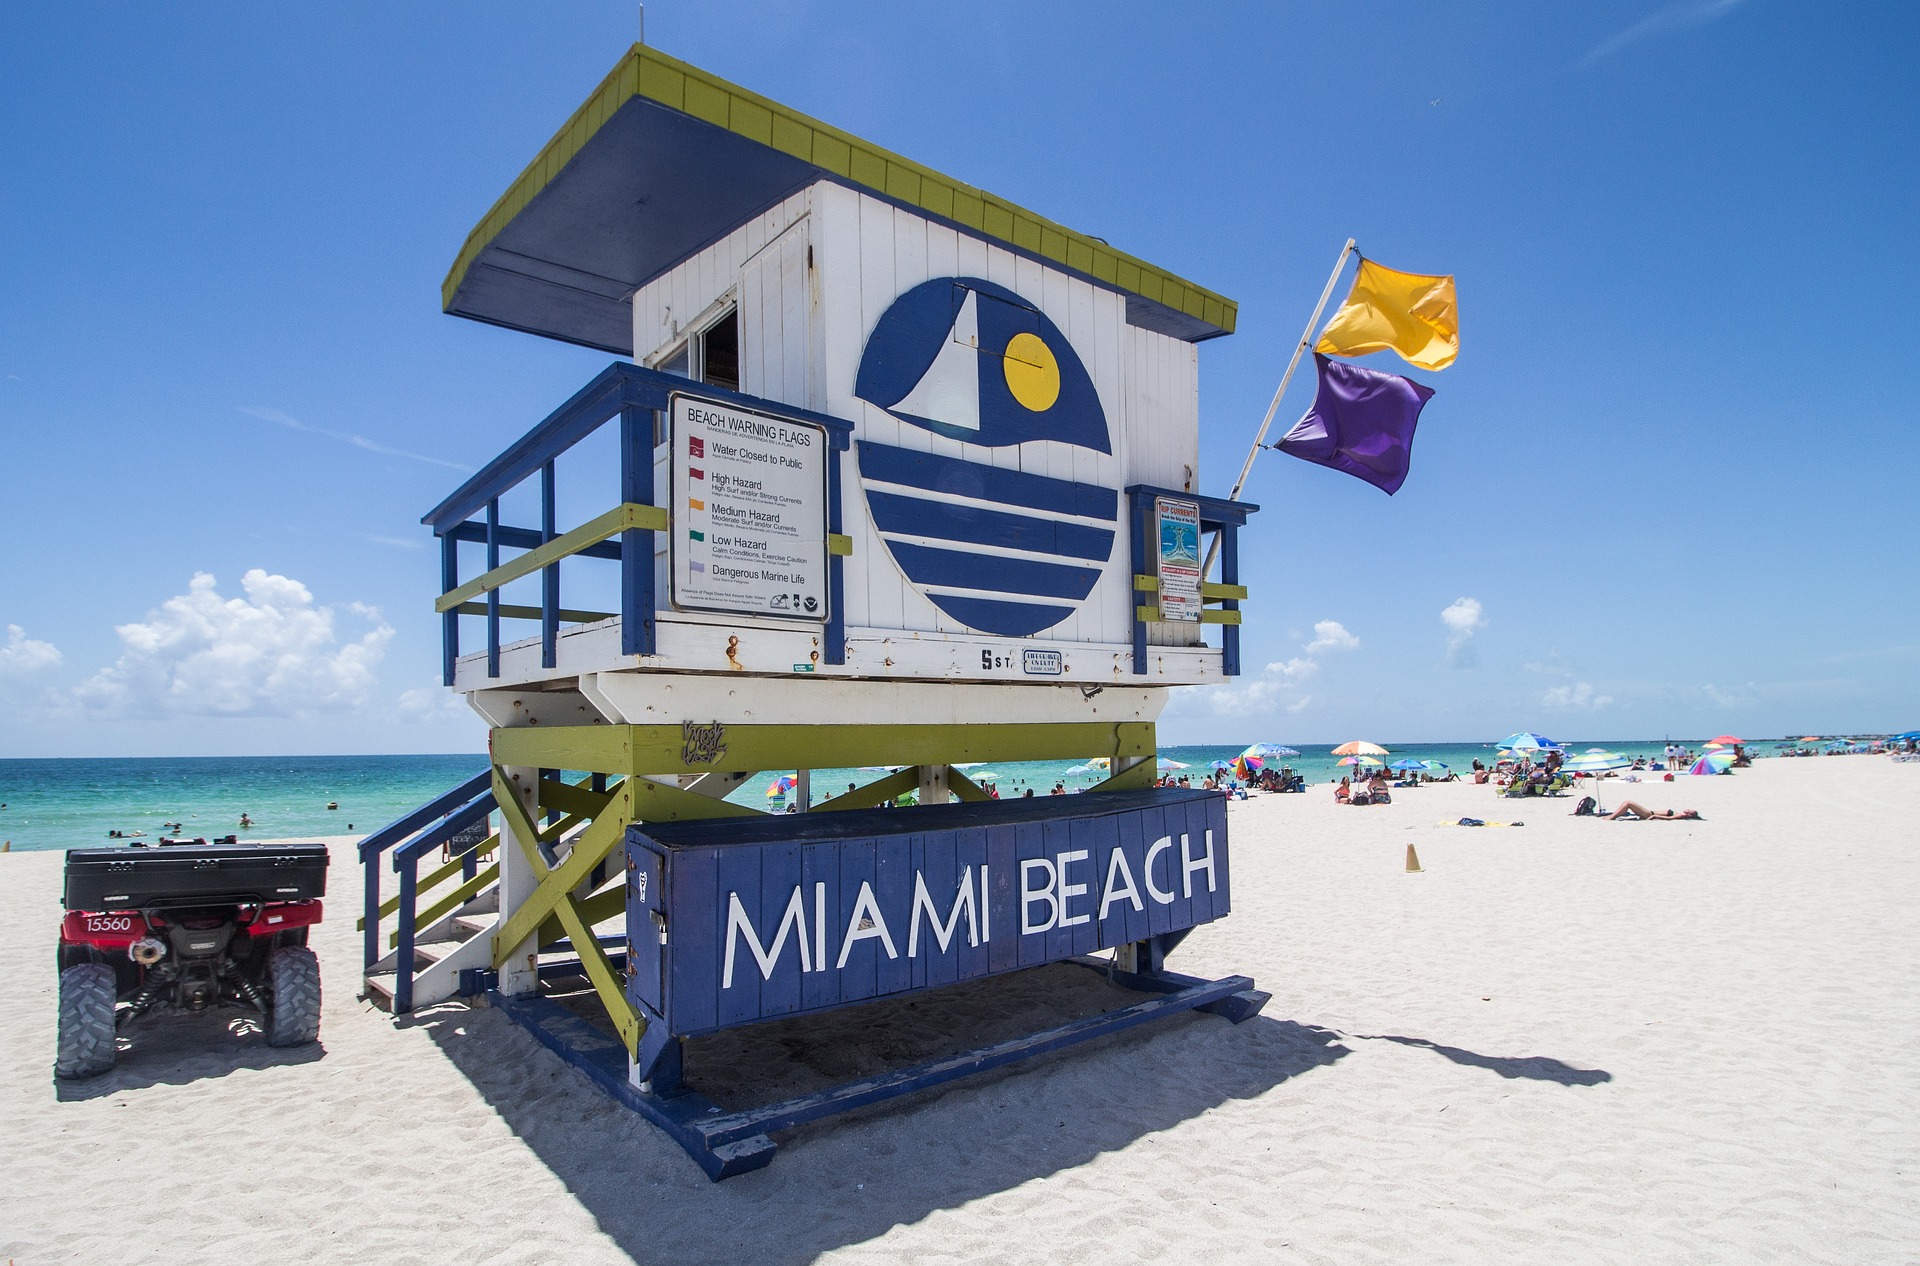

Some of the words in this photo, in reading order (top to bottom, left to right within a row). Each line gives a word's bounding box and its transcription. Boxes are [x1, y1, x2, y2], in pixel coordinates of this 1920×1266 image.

[688, 408, 725, 428] BEACH
[728, 417, 777, 439] WARNING
[779, 429, 810, 447] FLAGS
[712, 442, 737, 456] Water
[739, 448, 768, 462] Closed
[770, 454, 778, 465] to
[780, 456, 803, 470] Public
[711, 472, 730, 486] High
[732, 475, 762, 490] Hazard
[711, 484, 725, 492] High
[740, 489, 758, 497] and/or
[759, 492, 778, 501] Strong
[779, 495, 802, 505] Currents
[711, 503, 747, 518] Medium
[749, 509, 780, 523] Hazard
[1160, 505, 1169, 513] RIP
[1170, 507, 1197, 518] CURRENTS
[712, 514, 740, 524] Moderate
[741, 518, 754, 526] Surf
[754, 520, 772, 529] and/or
[773, 523, 797, 532] Currents
[712, 534, 731, 545] Low
[734, 537, 767, 551] Hazard
[712, 546, 729, 554] Calm
[729, 548, 760, 558] Conditions,
[762, 553, 786, 561] Exercise
[786, 556, 808, 564] Caution
[712, 564, 759, 579] Dangerous
[761, 570, 789, 583] Marine
[790, 574, 805, 584] Life
[722, 864, 990, 989] MIAMI
[1020, 829, 1217, 936] BEACH
[87, 917, 131, 932] 15560
